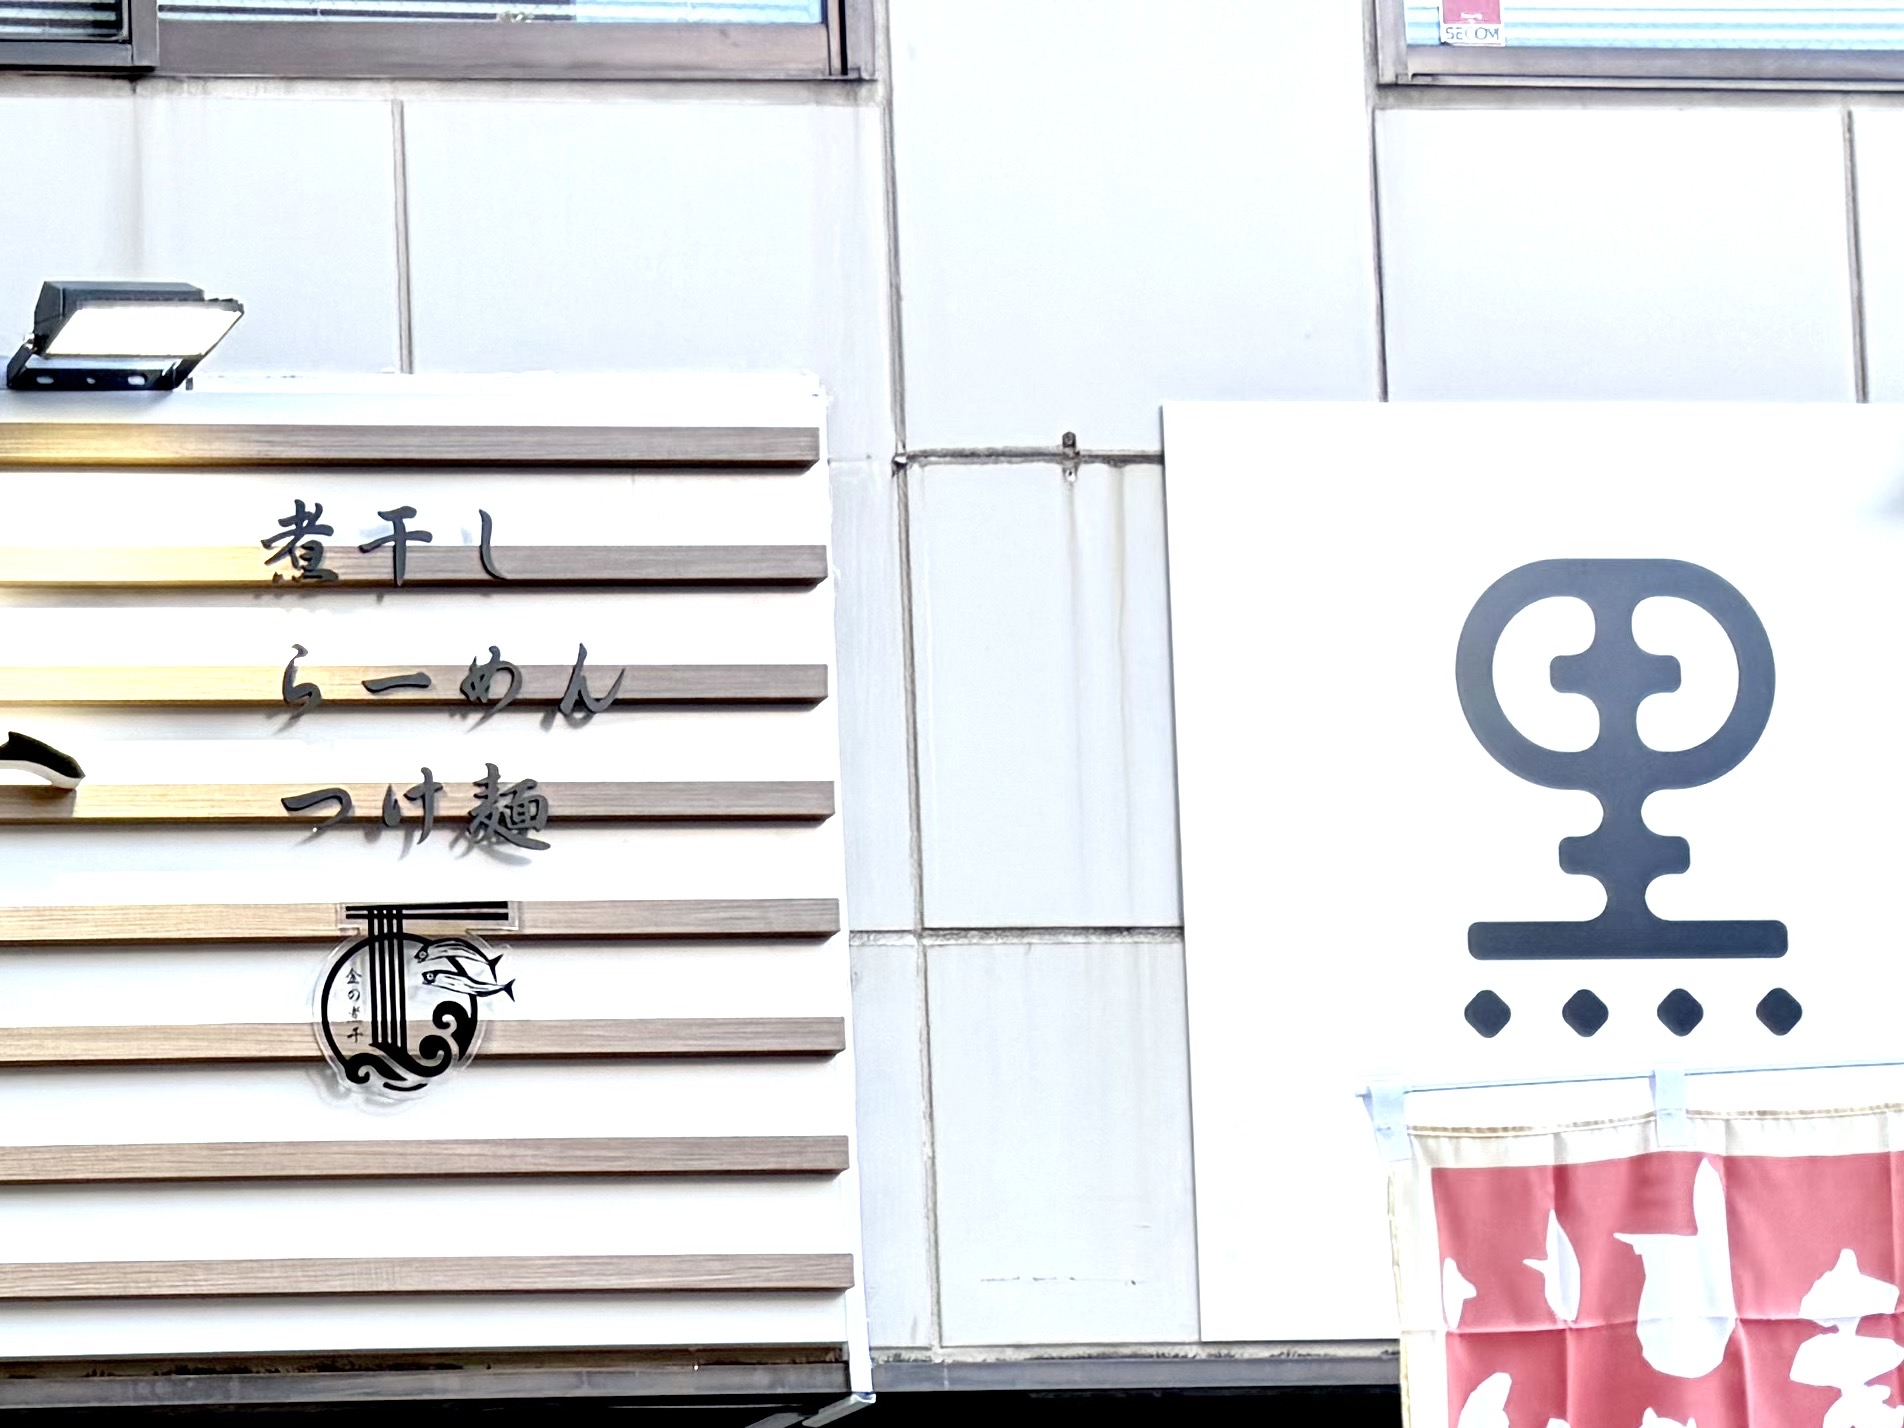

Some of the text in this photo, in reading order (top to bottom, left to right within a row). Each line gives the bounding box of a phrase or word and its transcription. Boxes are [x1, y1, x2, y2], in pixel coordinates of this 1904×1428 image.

[260, 499, 509, 588] 煮干し
[281, 642, 626, 714] らーめん
[281, 762, 552, 851] つけ麺
